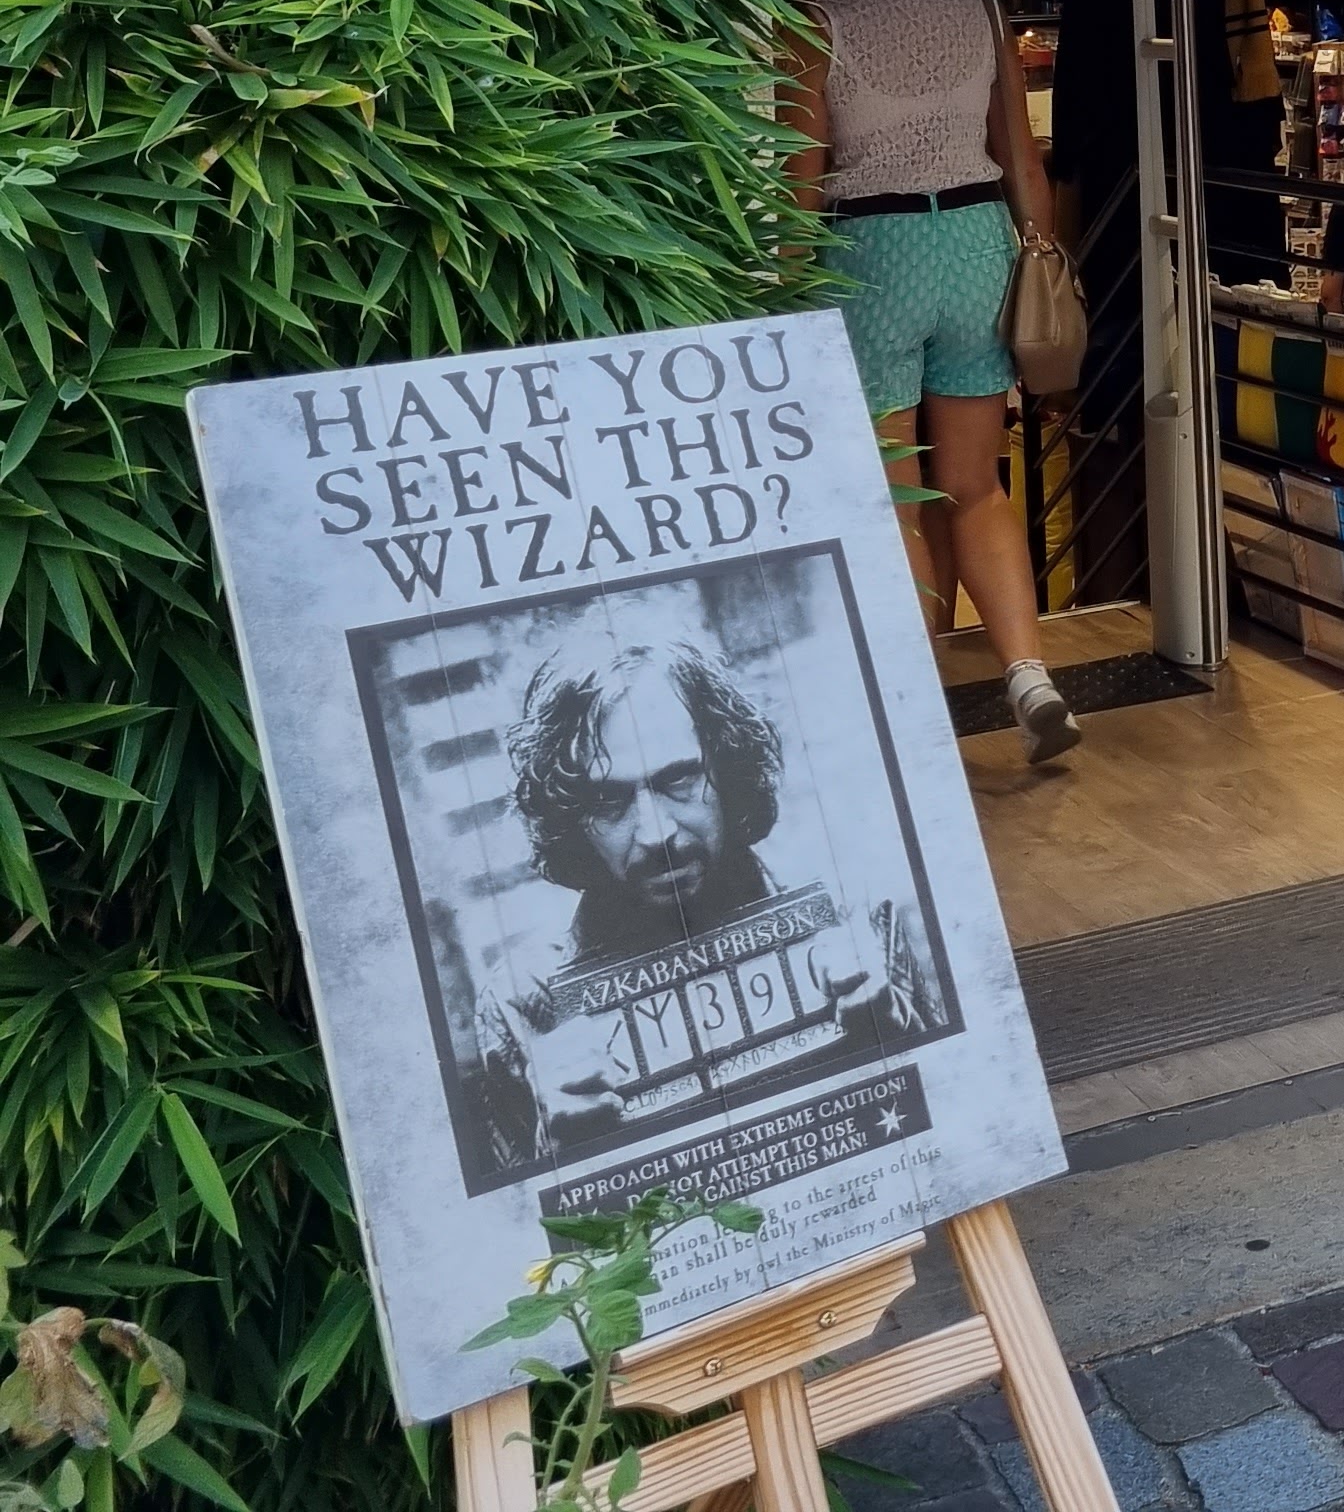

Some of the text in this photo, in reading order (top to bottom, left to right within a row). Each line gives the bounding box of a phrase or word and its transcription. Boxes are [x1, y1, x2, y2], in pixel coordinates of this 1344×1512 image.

[294, 330, 792, 458] HAVE YOU
[316, 400, 815, 537] SEEN THIS
[363, 473, 792, 604] WIZARD?
[578, 904, 816, 1013] AZKABAN PRISON
[557, 1075, 908, 1212] APPROACH WITH EXTREME CAUTION!
[694, 1131, 869, 1203] GAINST THIS MAN!
[708, 1141, 789, 1183] ATTEMPT
[792, 1131, 818, 1154] TO
[820, 1116, 858, 1142] USE
[783, 1198, 802, 1214] to
[807, 1185, 833, 1205] the
[839, 1165, 885, 1194] arrest
[890, 1152, 908, 1174] of
[912, 1144, 942, 1167] this
[639, 1192, 943, 1317] mmediately by owl the Ministry of Magic
[687, 1240, 729, 1272] shall
[733, 1235, 754, 1254] be
[759, 1217, 797, 1243] duly
[804, 1185, 879, 1229] rewarded
